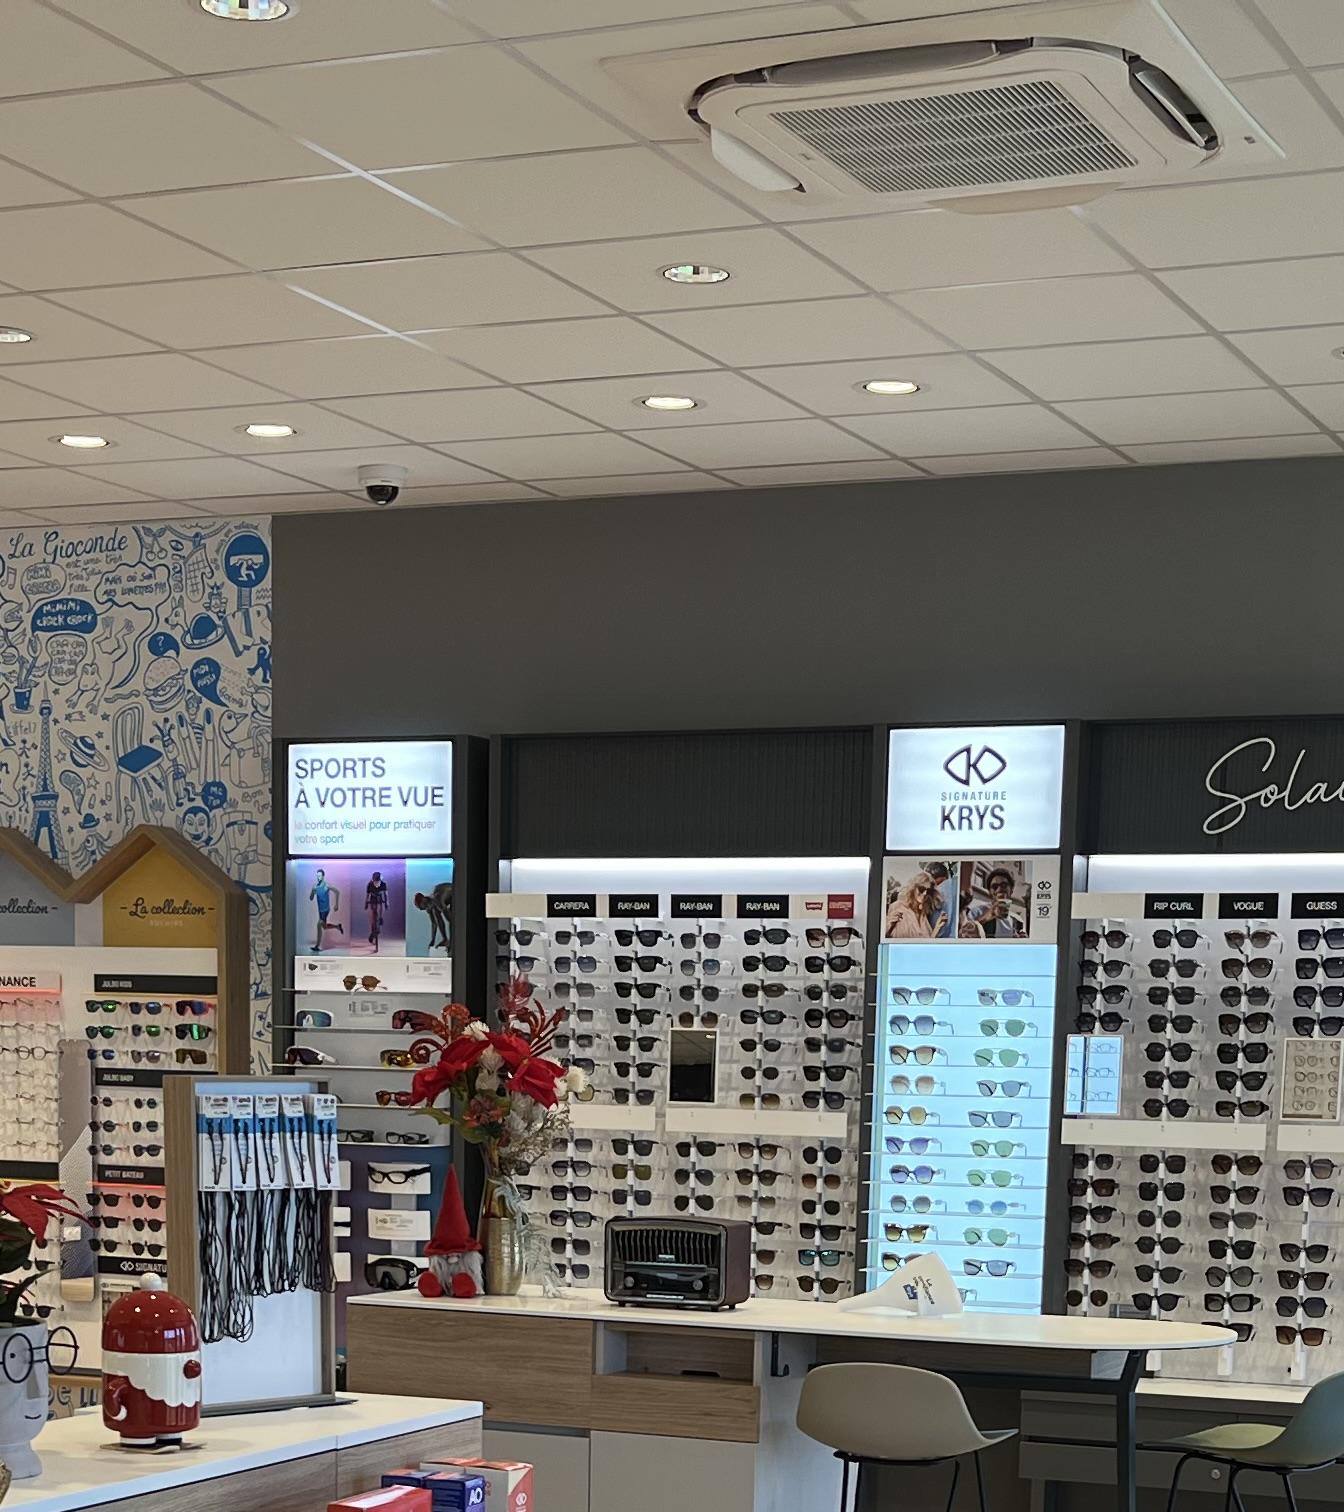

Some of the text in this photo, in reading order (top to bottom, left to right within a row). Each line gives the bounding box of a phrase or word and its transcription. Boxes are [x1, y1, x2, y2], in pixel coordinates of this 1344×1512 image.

[8, 530, 129, 566] La Gioconde
[294, 756, 387, 779] SPORTS
[294, 782, 445, 809] À VOTRE VUE
[940, 790, 1008, 802] SIGNATURE
[939, 802, 1006, 832] KRYS
[305, 819, 338, 831] confort
[340, 818, 367, 830] visuel
[369, 820, 391, 834] pour
[393, 818, 437, 834] pratiquer
[294, 833, 345, 847] votre sport
[128, 896, 207, 918] La collection
[553, 900, 590, 912] CARRERA
[617, 900, 651, 912] RAY-BAN
[679, 901, 714, 912] RAY-BAN
[745, 901, 781, 912] RAY-BAN
[1153, 900, 1195, 912] RIP CURL
[1232, 900, 1265, 912] VOGUE
[1306, 900, 1338, 912] GUESS
